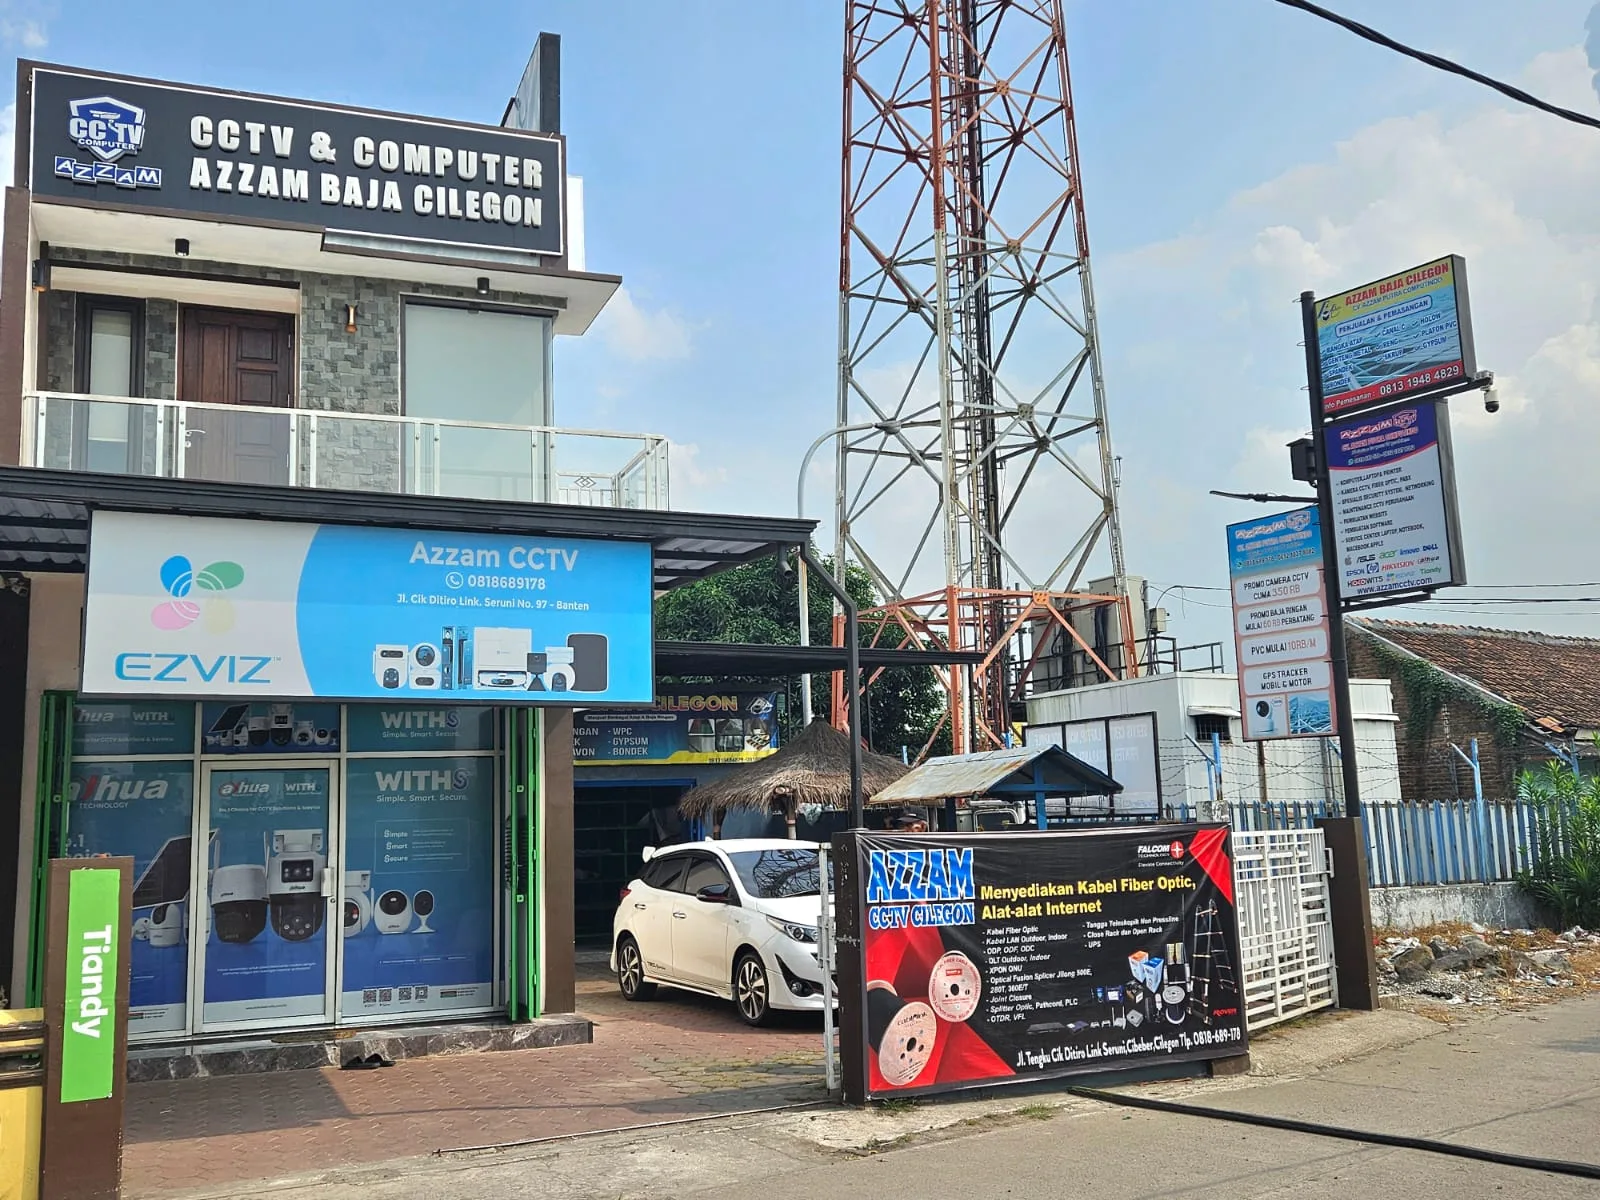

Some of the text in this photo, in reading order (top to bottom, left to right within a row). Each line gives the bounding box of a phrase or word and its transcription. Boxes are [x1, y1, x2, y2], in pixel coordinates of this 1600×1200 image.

[78, 137, 137, 151] COMPUTER
[190, 115, 543, 188] CCTV & COMPUTER
[55, 156, 161, 187] AZZAM
[190, 157, 542, 227] AZZAM BAJA CILEGON
[1345, 262, 1449, 306] AZZAM BAJA CILEGON
[1382, 289, 1402, 302] PUTRA
[1338, 300, 1428, 333] PENJUALAN PEMASANGAN
[1382, 326, 1400, 337] CANAL
[1421, 320, 1457, 336] PLAFON PVC
[1326, 342, 1349, 353] RANGKA
[1383, 339, 1398, 348] RENG
[1328, 354, 1353, 365] GENTENG
[1329, 366, 1353, 376] SPANDEK
[1336, 365, 1459, 407] Pemesanan 0813 1948 4829
[1341, 487, 1358, 495] KAMERA
[1364, 491, 1384, 500] SECURITY
[1405, 480, 1435, 491] NETWORKING
[1343, 495, 1414, 514] MAINTENANCE CCTV PERUSAHAAN
[1344, 511, 1387, 524] PEMBUATAN WEBSITE
[1345, 520, 1393, 534] PEMBUATAN SOFTWARE
[1346, 534, 1363, 542] SERVICE
[1364, 531, 1380, 539] CENTER
[1370, 541, 1384, 549] APPLE
[409, 540, 579, 571] Azzam CCTV
[1357, 544, 1438, 563] ASUS acer DELL
[1346, 560, 1414, 576] EPSON HIKVISION
[1420, 566, 1441, 575] Tiandy
[467, 573, 546, 590] 0818689178
[1244, 572, 1309, 590] PROMO CAMERA CCTV
[1357, 577, 1432, 594] www.azzamcctv.com
[1253, 584, 1301, 600] CUMA 350 RB
[484, 598, 515, 608] Seruni
[517, 599, 534, 609] No.
[536, 600, 547, 609] 97
[557, 601, 589, 611] Banten
[1250, 604, 1307, 620] PROMO BAJA RINGAN
[1281, 613, 1315, 625] PERBATANG
[1251, 638, 1316, 655] PVC MULAI 10RB/M
[115, 652, 271, 683] EZVIZ
[1263, 667, 1308, 679] GPS TRACKER
[1261, 681, 1280, 690] MOBIL
[1289, 677, 1312, 687] MOTOR
[573, 727, 632, 735] NGAN WPC
[613, 737, 648, 745] GYPSUM
[613, 748, 648, 756] BONDEK
[376, 794, 407, 804] Simple.
[384, 829, 408, 838] Simple
[386, 842, 408, 850] Smart
[384, 854, 408, 863] Secure
[867, 848, 976, 903] AZZAM
[980, 875, 1196, 901] Menyediakan Kabel Fiber Optic,
[868, 902, 976, 929] CCTV CILEGON
[982, 899, 1102, 920] Alat-alat Internet
[986, 928, 1004, 936] Kabel
[1022, 926, 1039, 935] Optic
[1086, 921, 1108, 929] Tangga
[1105, 929, 1119, 937] Rack
[1121, 928, 1131, 936] dan
[1133, 928, 1147, 936] Open
[1148, 926, 1162, 934] Rack
[986, 937, 1005, 945] Kabel
[1006, 936, 1019, 944] LAN
[1021, 935, 1047, 943] Outdoor,
[1088, 941, 1101, 949] UPS
[1001, 955, 1028, 963] Outdoor,
[1029, 953, 1050, 961] Indoor
[72, 925, 112, 1038] Tiandy
[990, 976, 1011, 985] Optical
[1034, 972, 1056, 981] Splicer
[1008, 994, 1032, 1002] Closure
[990, 1005, 1013, 1014] Splitter
[1016, 1027, 1241, 1068] Jl. Tengku Cik Ditiro Link Tlp. 0818-689-178
